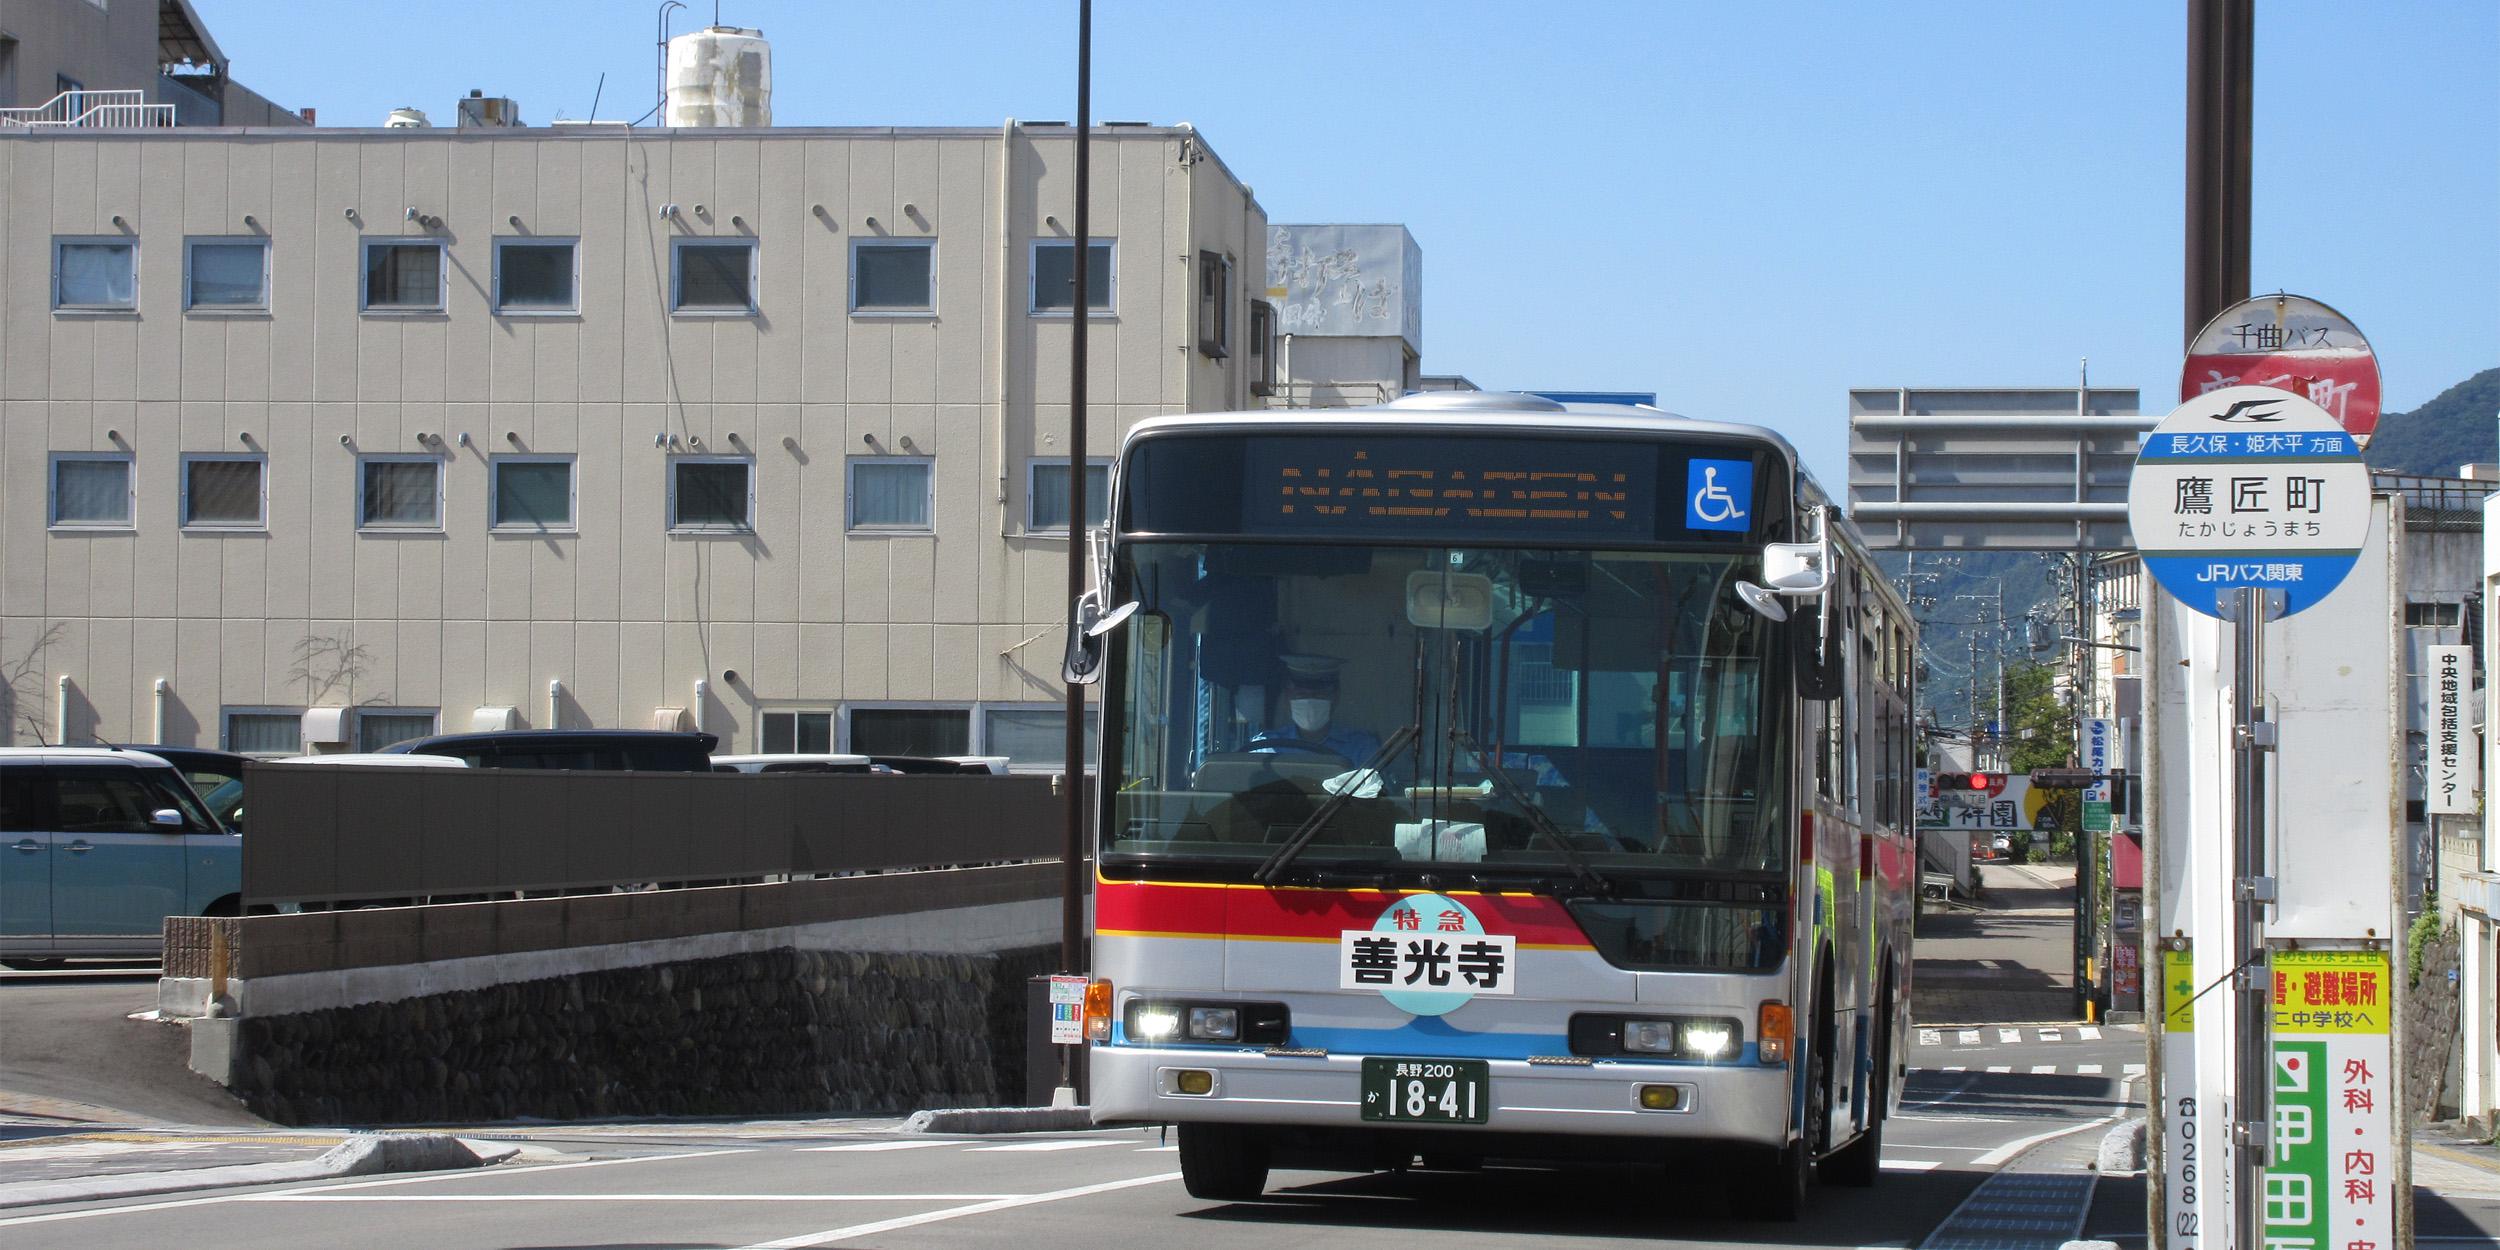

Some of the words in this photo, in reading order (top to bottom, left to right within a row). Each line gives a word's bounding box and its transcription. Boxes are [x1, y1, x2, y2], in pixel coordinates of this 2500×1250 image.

[2231, 323, 2333, 350] 千曲バス
[2171, 435, 2303, 454] 長久保・姫木平
[2310, 437, 2343, 453] 方面
[2173, 475, 2326, 515] 鷹匠町
[2178, 520, 2321, 538] たかじょうまち
[2196, 563, 2304, 582] JRバス関東
[2440, 653, 2459, 807] 中央地域包括支援センター
[1392, 908, 1467, 932] 特急
[1351, 936, 1505, 989] 善光寺
[2273, 1010, 2375, 1028] 二中学校へ
[1367, 1091, 1380, 1104] か
[1389, 1079, 1476, 1118] 18-41
